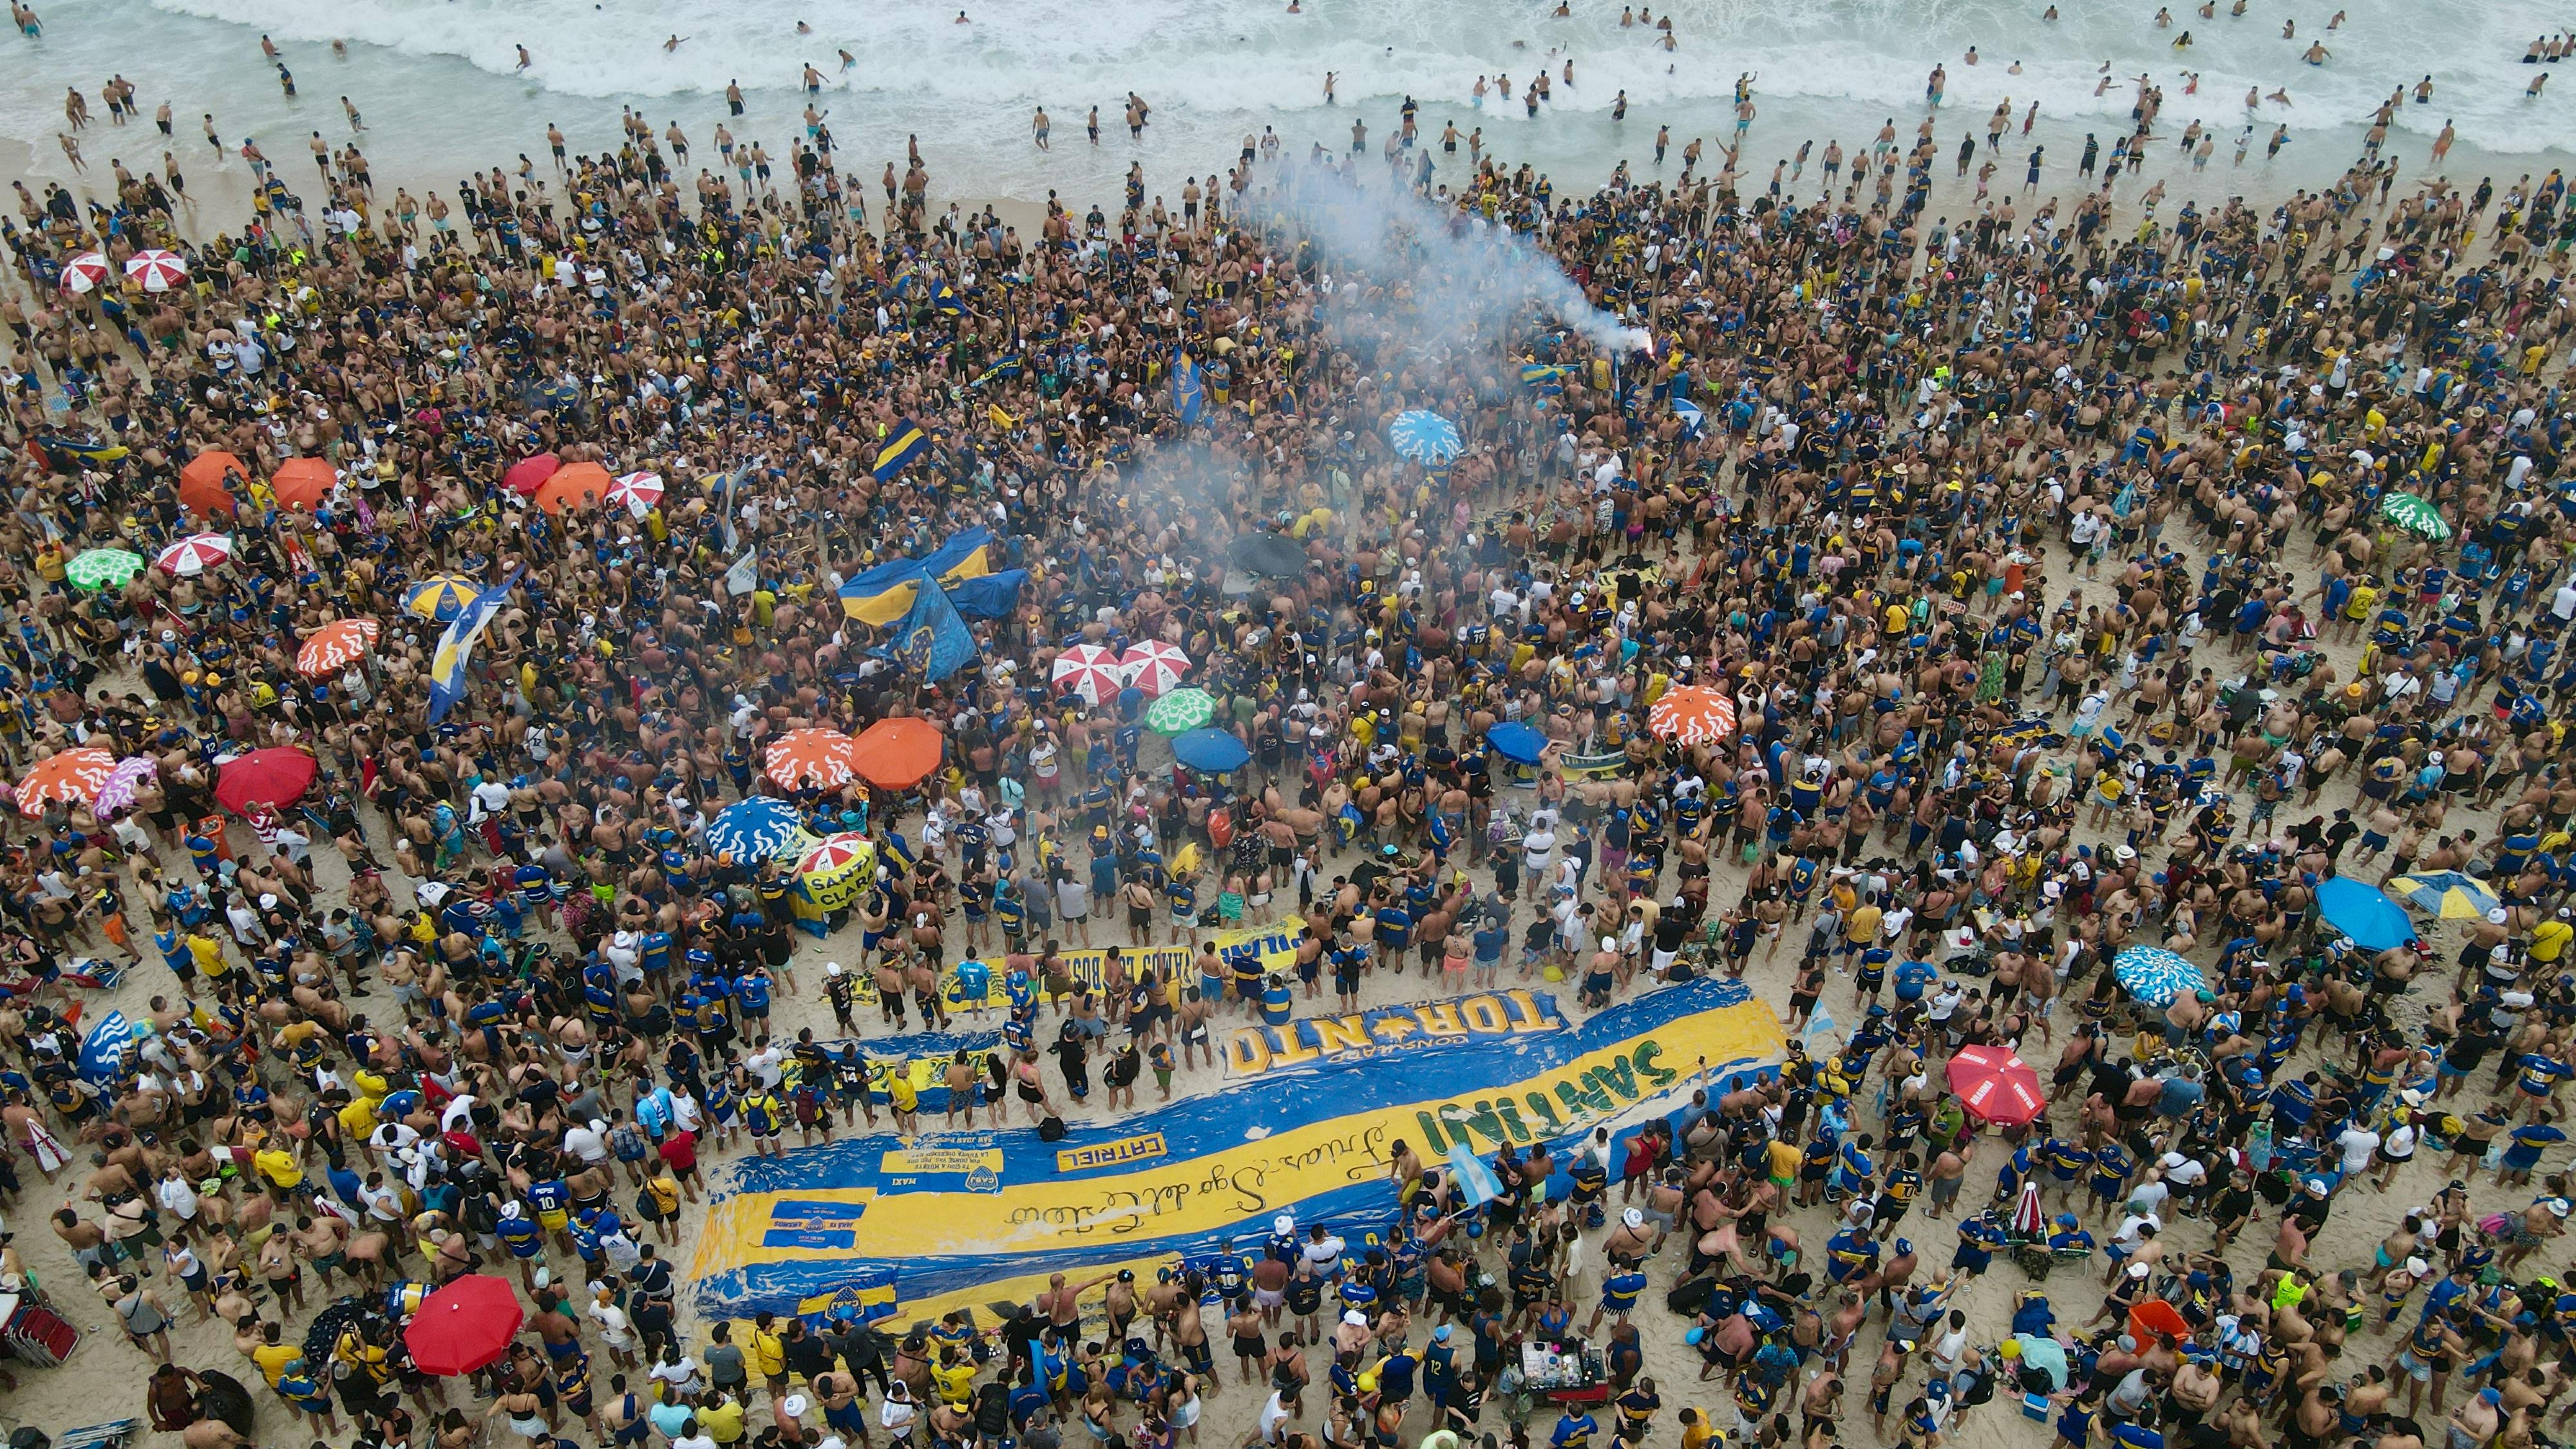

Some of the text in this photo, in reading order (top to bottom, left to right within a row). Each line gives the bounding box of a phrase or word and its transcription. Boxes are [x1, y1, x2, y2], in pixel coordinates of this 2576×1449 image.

[1618, 620, 1625, 634] 12
[1474, 633, 1485, 643] 19
[205, 743, 216, 753] 12
[533, 738, 542, 746] 12
[2287, 762, 2296, 772] 12
[1795, 869, 1808, 884] 12
[819, 867, 871, 904] CLARA
[1958, 1051, 1989, 1066] BRAHMA
[841, 1071, 858, 1083] 14
[2530, 1070, 2546, 1082] 19
[1416, 1041, 1676, 1156] SANTINI
[1970, 1079, 1995, 1106] BRAHMA
[2013, 1082, 2036, 1110] BRAHMA
[1899, 1124, 1919, 1138] 10
[1062, 1137, 1162, 1166] CATRIEL
[891, 1177, 917, 1186] MAXI
[1902, 1186, 1915, 1198] 10
[538, 1197, 556, 1209] 10
[1220, 1273, 1237, 1287] 10
[1431, 1359, 1441, 1376] 12
